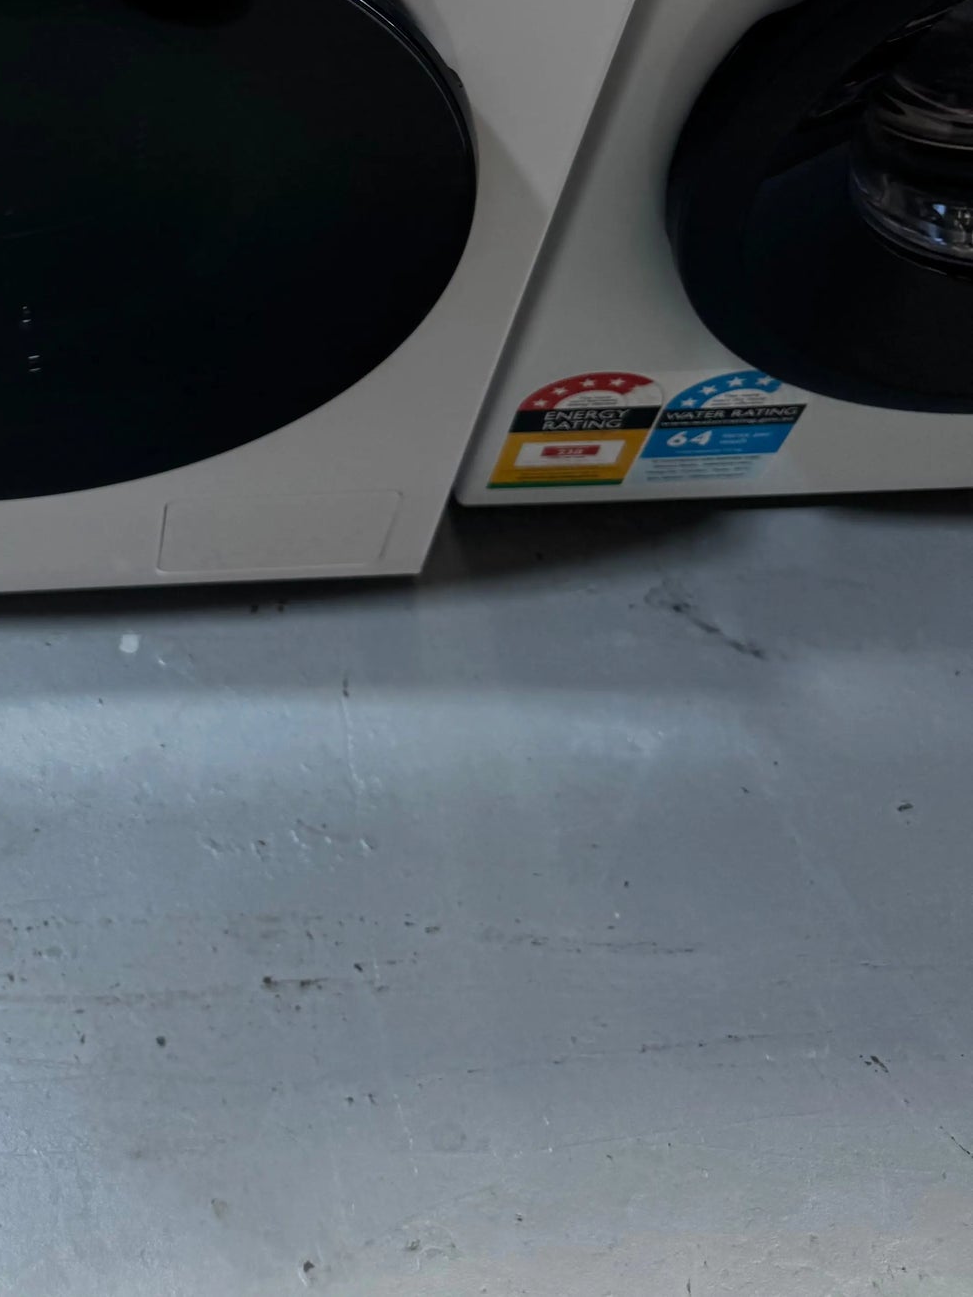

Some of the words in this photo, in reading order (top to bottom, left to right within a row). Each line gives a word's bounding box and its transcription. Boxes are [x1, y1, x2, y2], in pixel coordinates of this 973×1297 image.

[543, 408, 631, 421] ENERGY
[665, 409, 725, 420] WATER
[730, 406, 799, 417] RATING
[541, 418, 624, 431] RATING
[665, 429, 714, 447] 64
